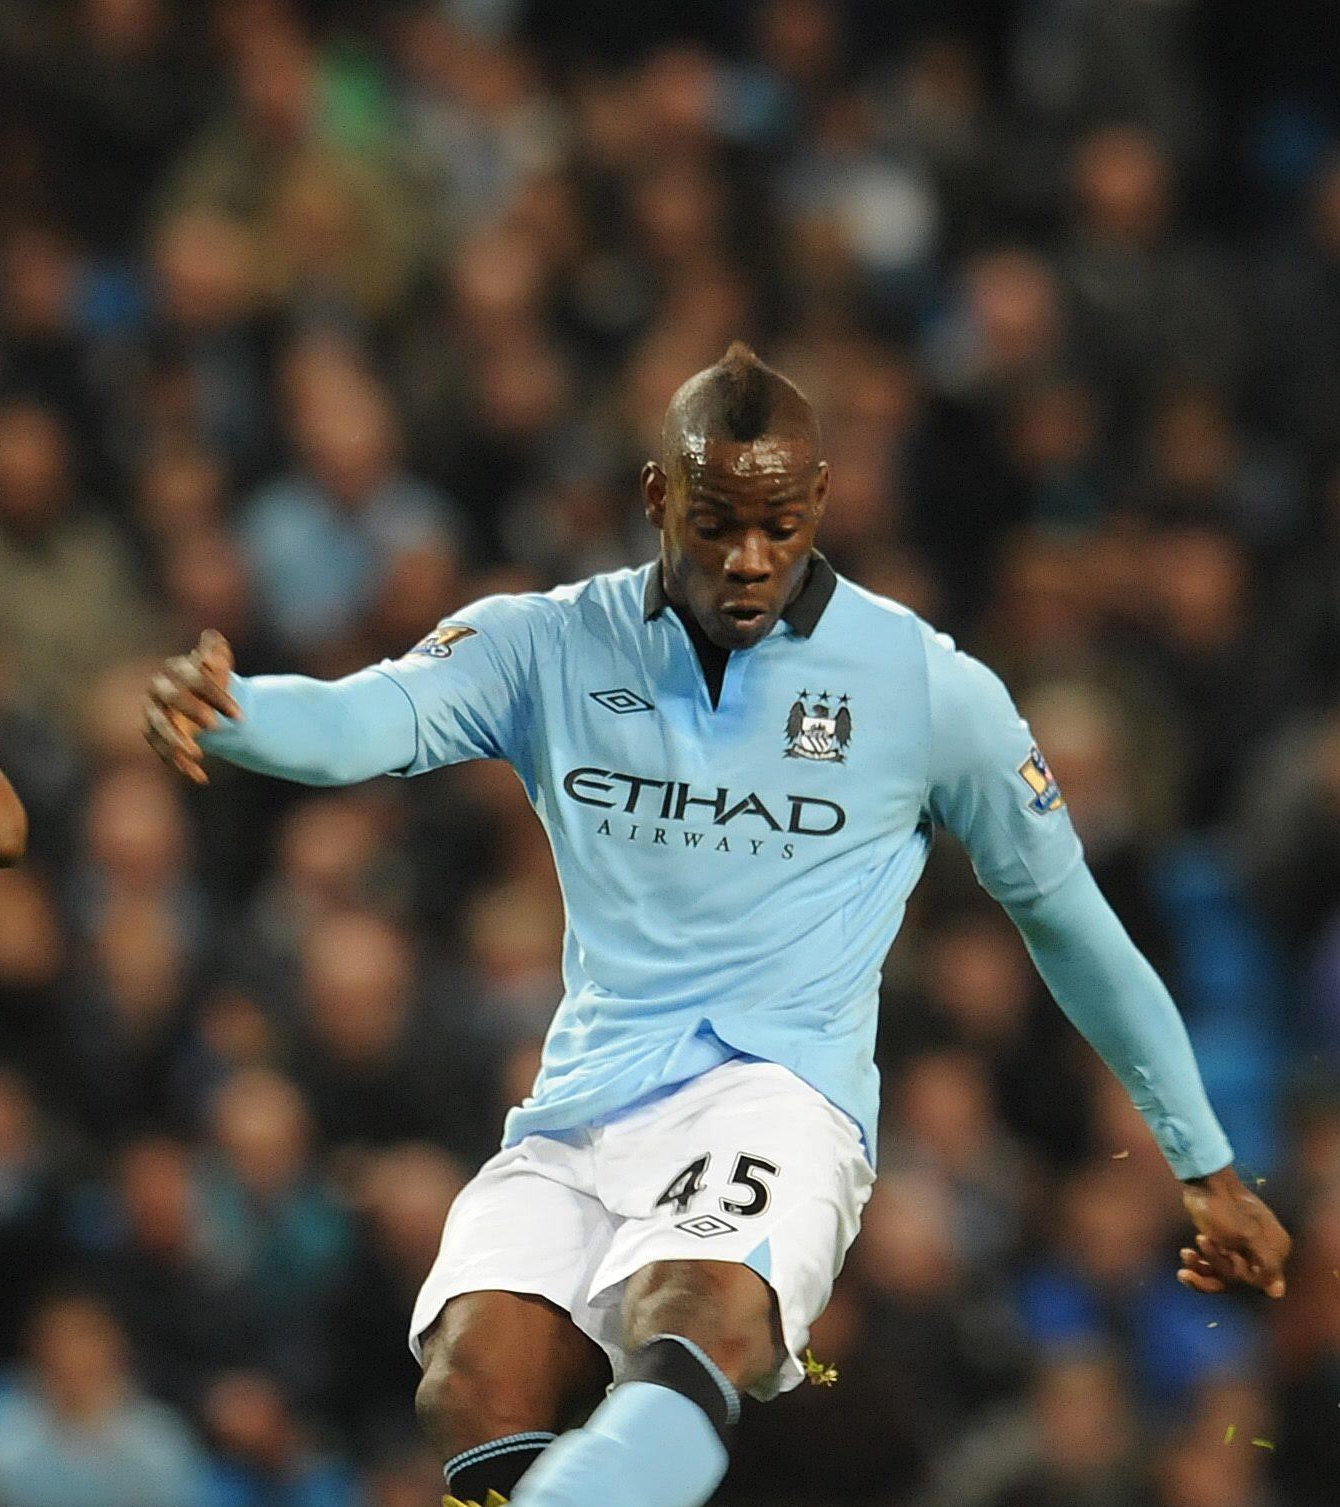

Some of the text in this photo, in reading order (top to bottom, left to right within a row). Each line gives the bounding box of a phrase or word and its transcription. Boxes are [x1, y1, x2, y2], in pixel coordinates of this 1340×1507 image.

[562, 766, 847, 837] ETIHAD
[596, 819, 796, 861] AIRWAYS
[651, 1151, 781, 1219] 45
